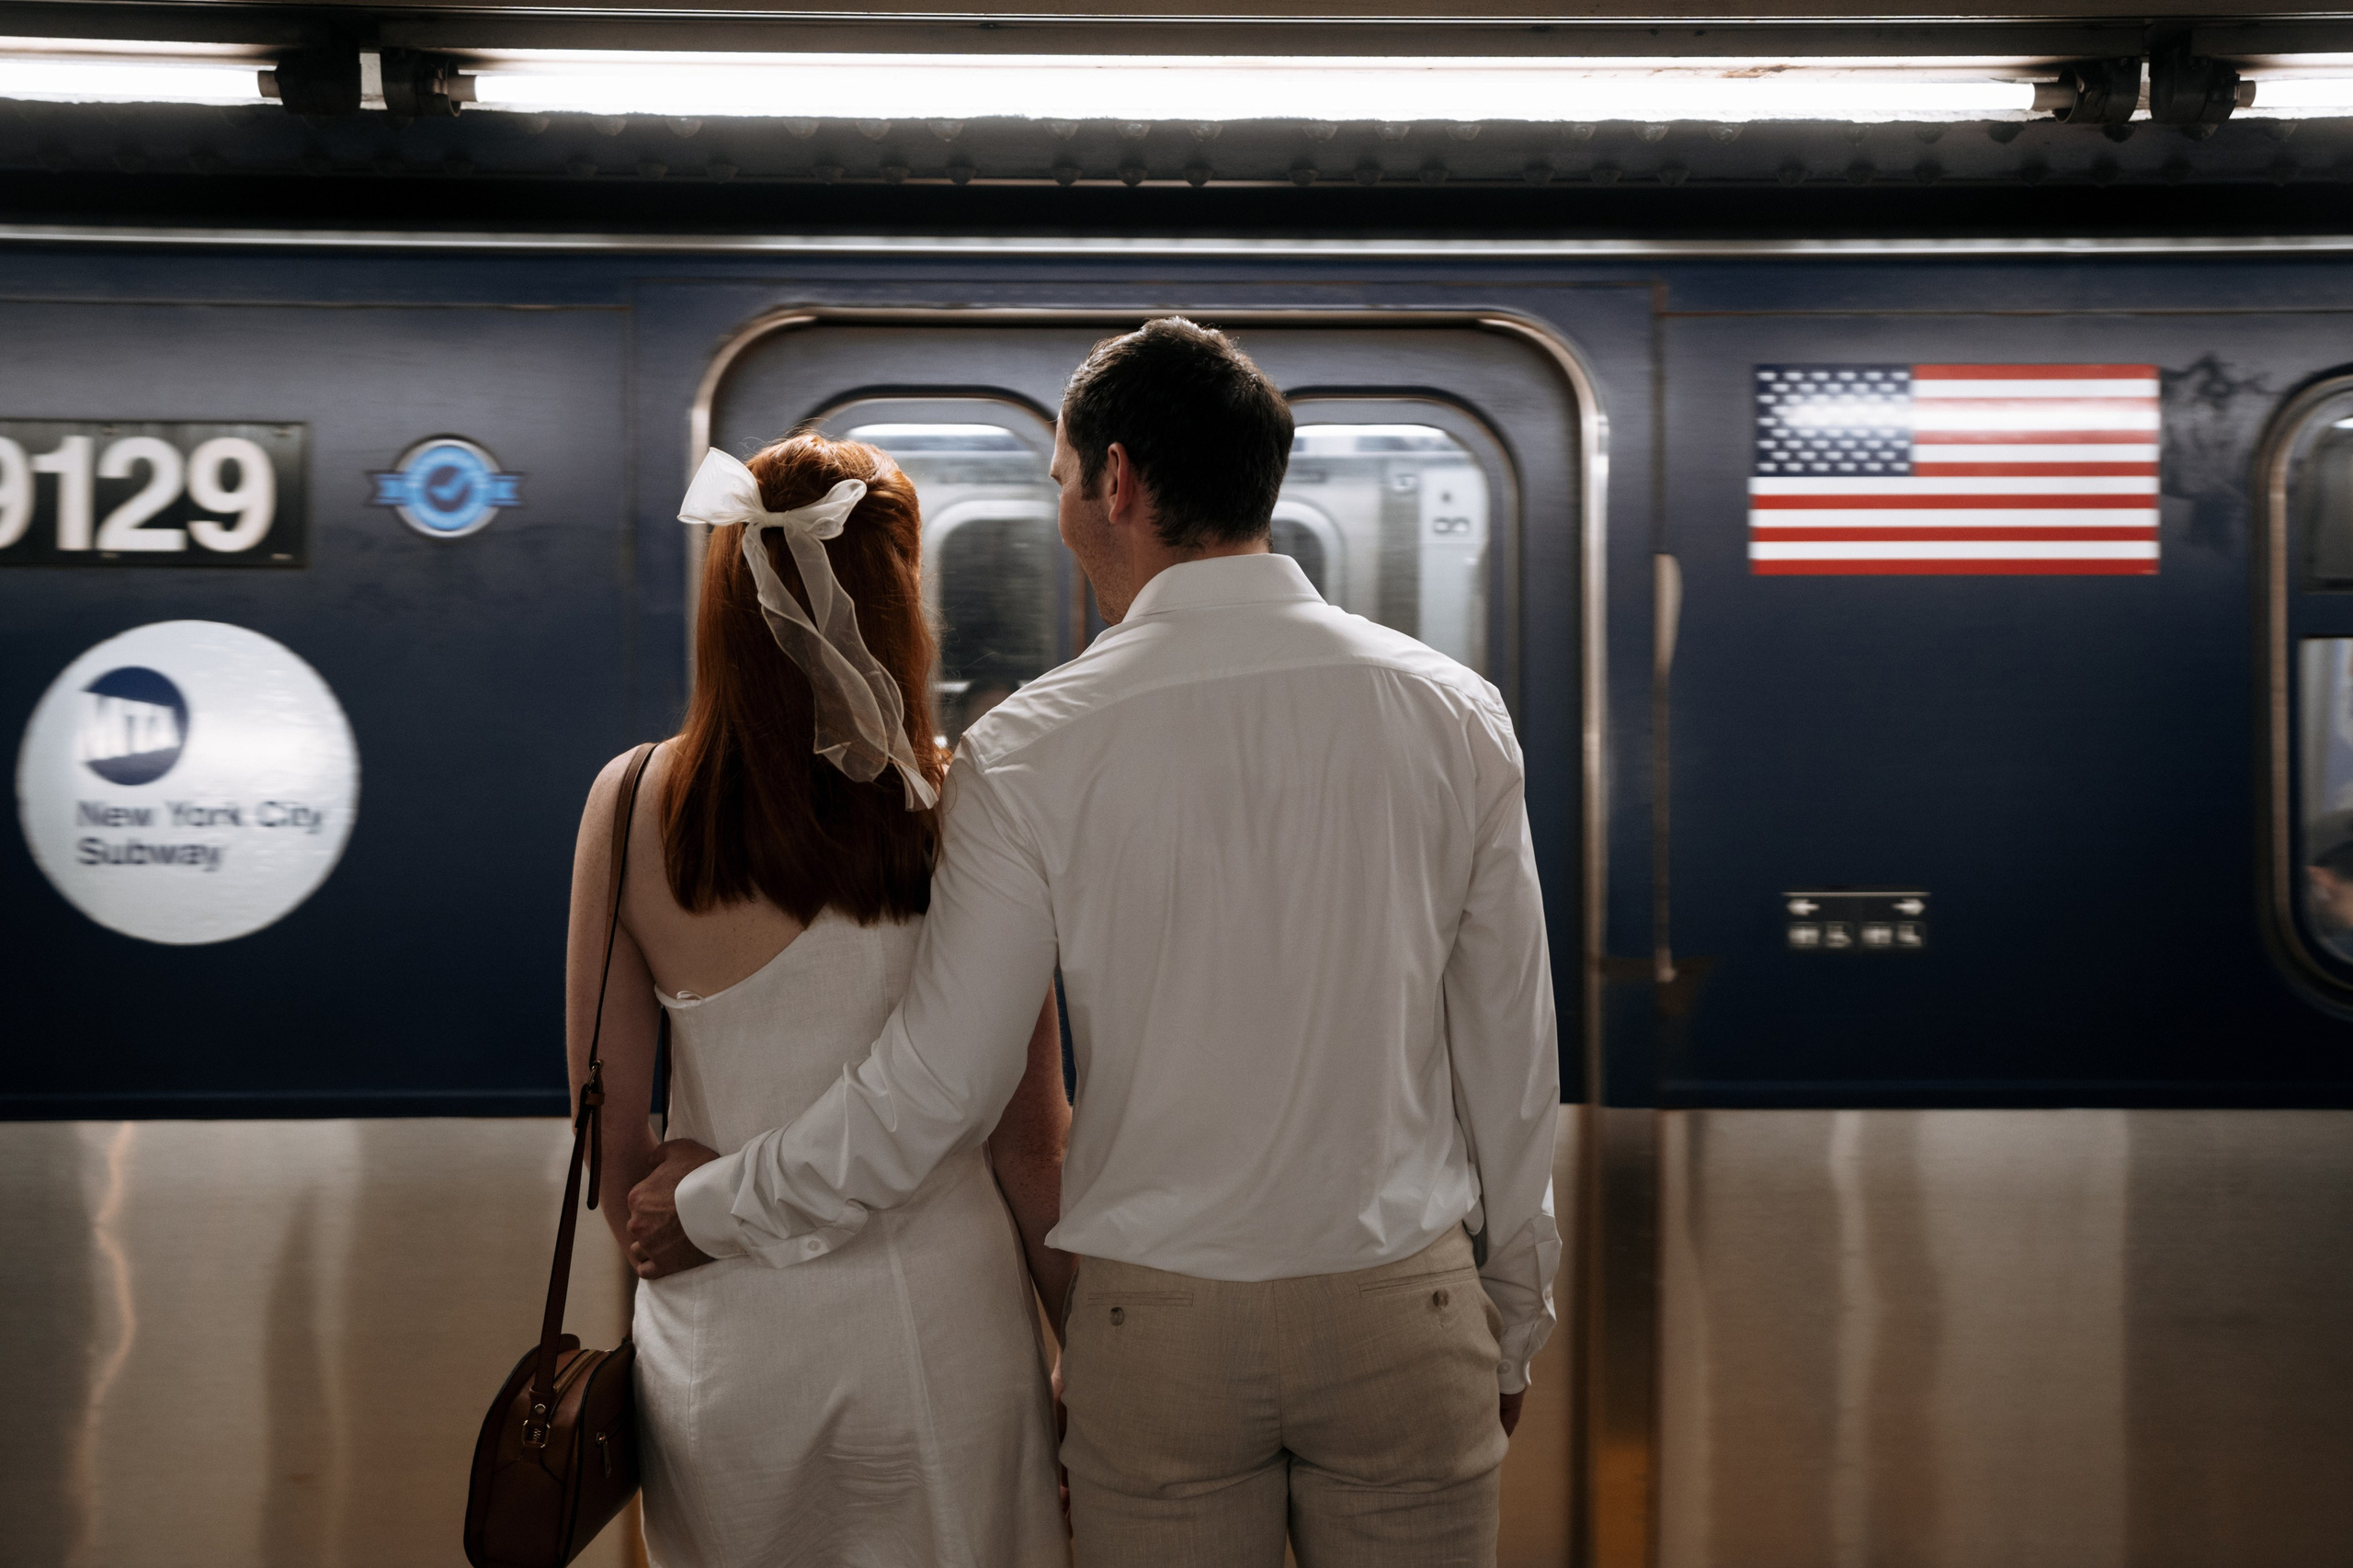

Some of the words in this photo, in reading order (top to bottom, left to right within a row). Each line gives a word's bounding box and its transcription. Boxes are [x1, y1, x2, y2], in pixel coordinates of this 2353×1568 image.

[76, 800, 152, 827] New
[165, 799, 244, 827] York
[254, 800, 324, 835] City
[75, 836, 225, 872] Subway
